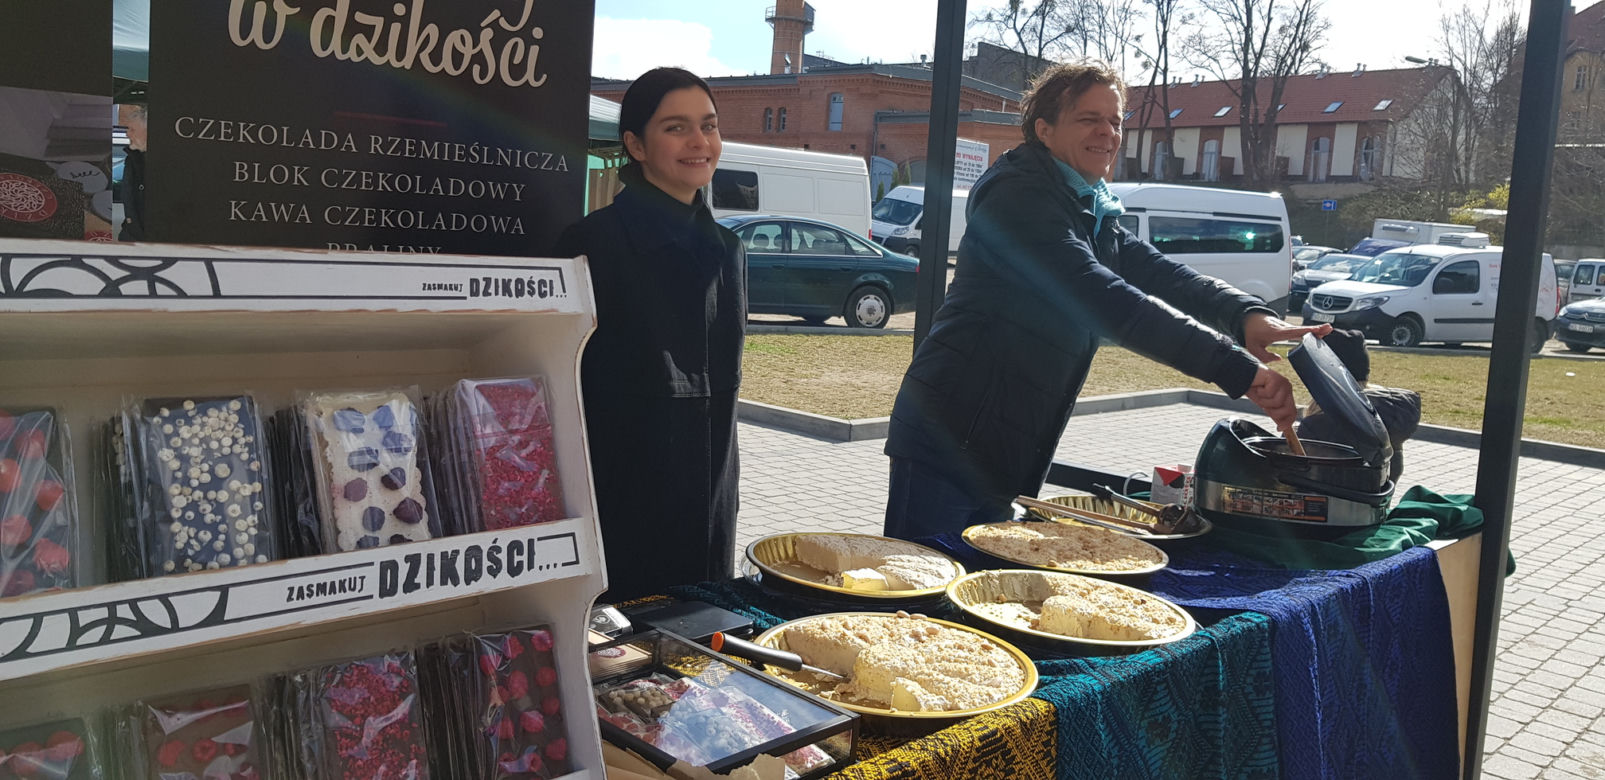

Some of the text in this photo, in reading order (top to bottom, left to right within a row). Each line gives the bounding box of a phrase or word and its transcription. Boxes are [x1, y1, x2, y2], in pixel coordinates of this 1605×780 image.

[310, 0, 548, 88] dzikości
[175, 116, 569, 172] CZEKOLADA RZEMIEŚLNICZA
[233, 161, 526, 201] BLOK CZEKOLADOWY
[229, 200, 526, 235] KAWA CZEKOLADOWA
[422, 282, 464, 293] ZASMAKUJ
[286, 575, 367, 602] ZASMAKUJ
